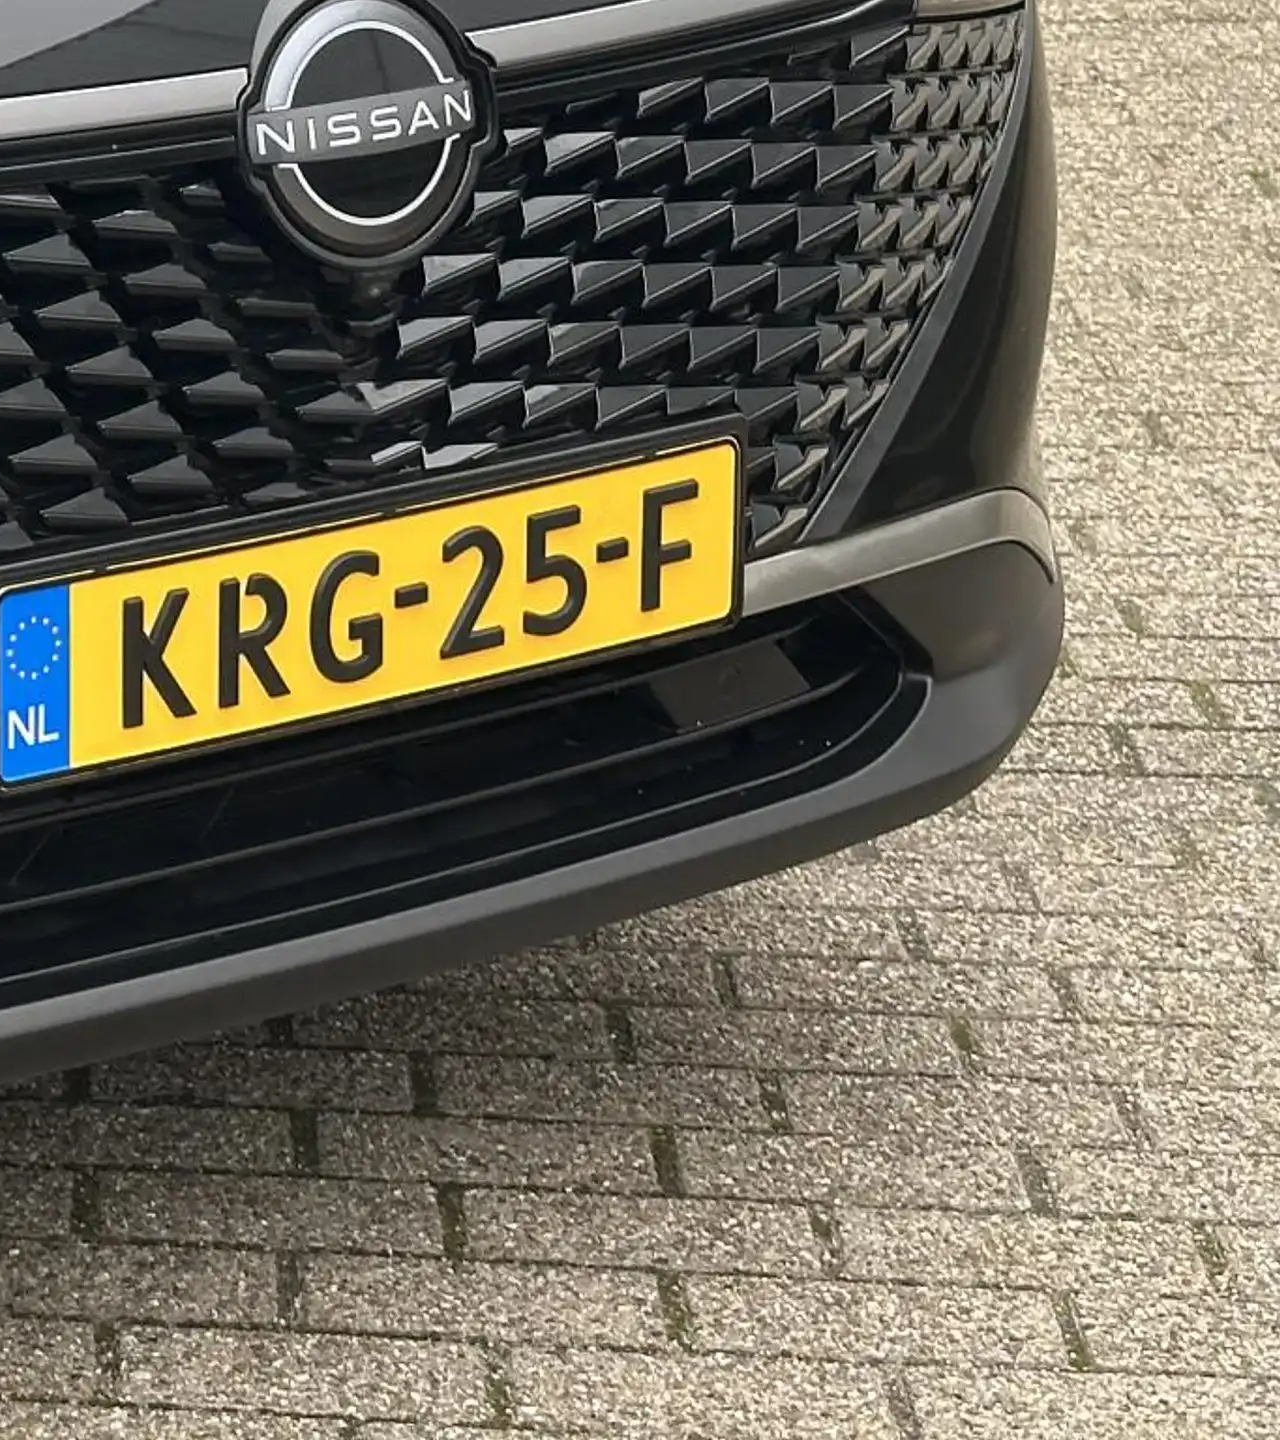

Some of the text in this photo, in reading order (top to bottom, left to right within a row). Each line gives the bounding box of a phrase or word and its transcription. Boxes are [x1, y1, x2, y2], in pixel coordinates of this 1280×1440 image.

[255, 90, 472, 155] NISSAN
[121, 478, 699, 730] KRG-25-F
[7, 702, 60, 750] NL
